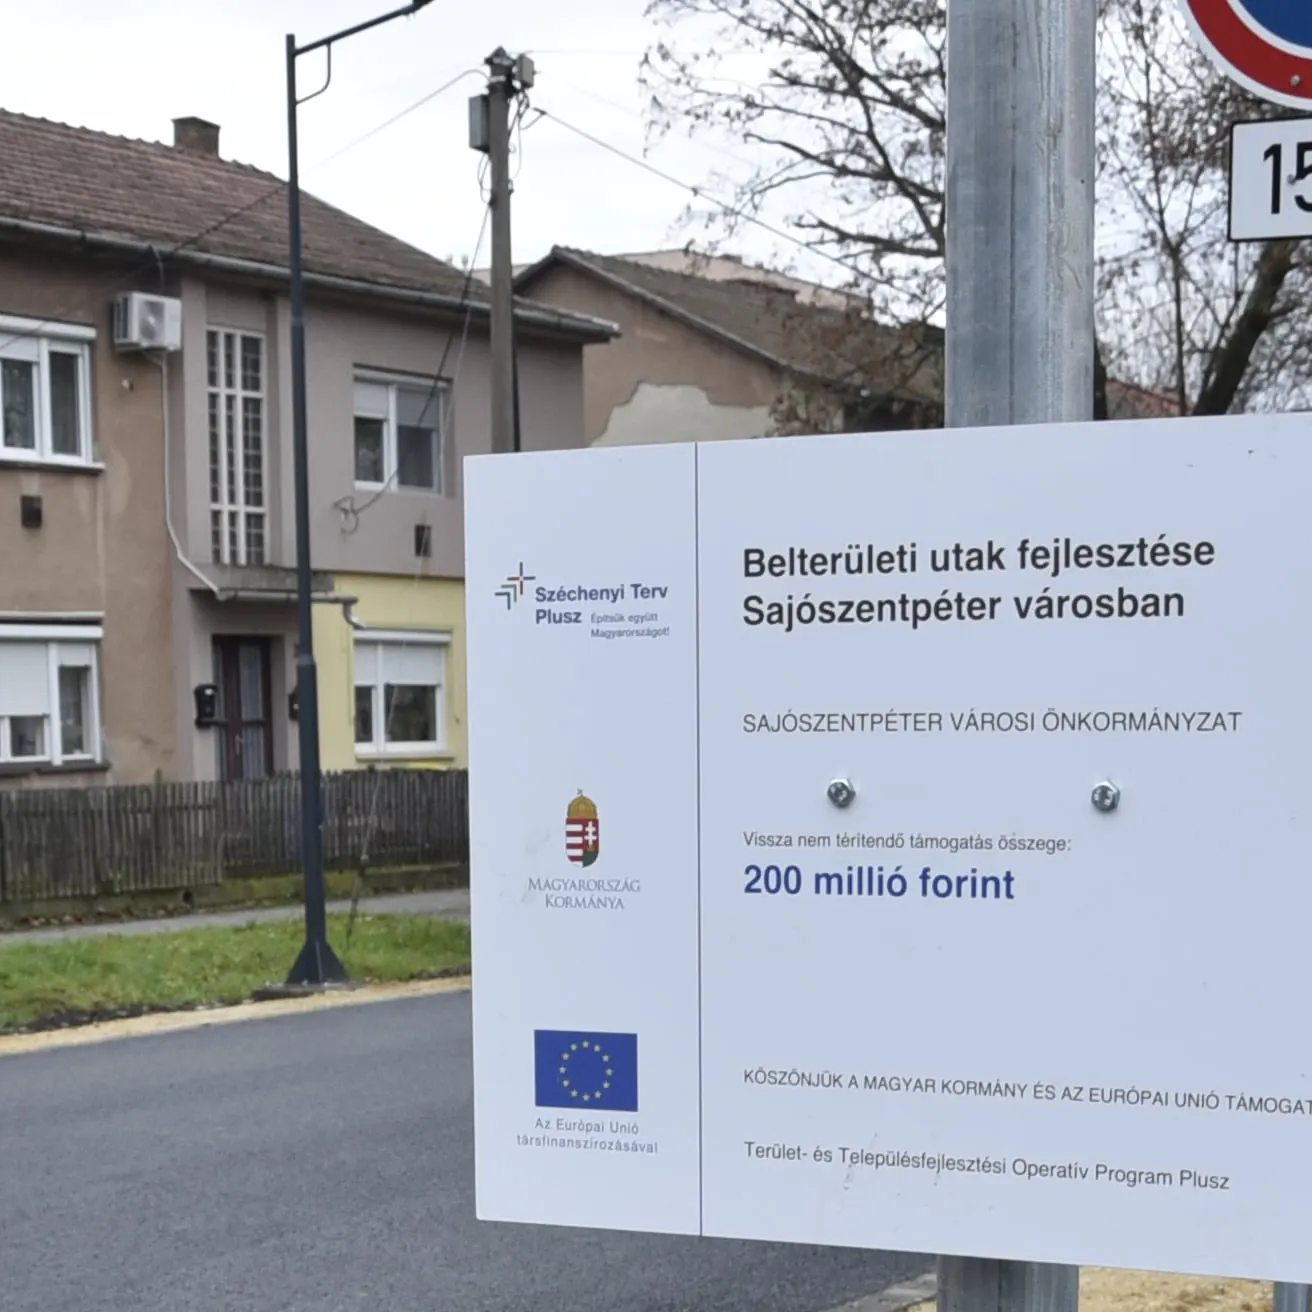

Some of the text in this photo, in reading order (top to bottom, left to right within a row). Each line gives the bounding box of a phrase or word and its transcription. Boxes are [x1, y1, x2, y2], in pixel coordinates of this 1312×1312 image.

[743, 534, 1216, 578] Belterületi utak fejlesztése
[535, 583, 669, 604] Széchenyi Terv
[536, 608, 582, 625] Plusz
[628, 613, 658, 625] együtt
[743, 587, 1185, 629] Sajószentpéter városban
[742, 706, 1243, 733] SAJÓSZENTPÉTER VÁROSI ÖNKORMÁNYZAT
[743, 831, 1072, 856] Vissza nem térítendő támogatás összege:
[528, 877, 640, 893] MAGYARORSZÁG
[744, 864, 1015, 900] 200 millió forint
[545, 894, 625, 910] KORMÁNYA
[743, 1067, 843, 1089] KÖSZÖNJÜK
[848, 1075, 859, 1089] A
[863, 1075, 936, 1093] MAGYAR
[941, 1079, 1028, 1099] KORMÁNY
[1033, 1081, 1056, 1100] ÉS
[1061, 1086, 1084, 1102] AZ
[1089, 1085, 1169, 1107] EURÓPAI
[1174, 1090, 1220, 1110] UNIÓ
[535, 1117, 639, 1135] Az Európai Unió
[516, 1133, 658, 1153] társfinanszírozásával
[744, 1141, 1230, 1190] Terület- és Településfejlesztési Operatív Program Plusz
